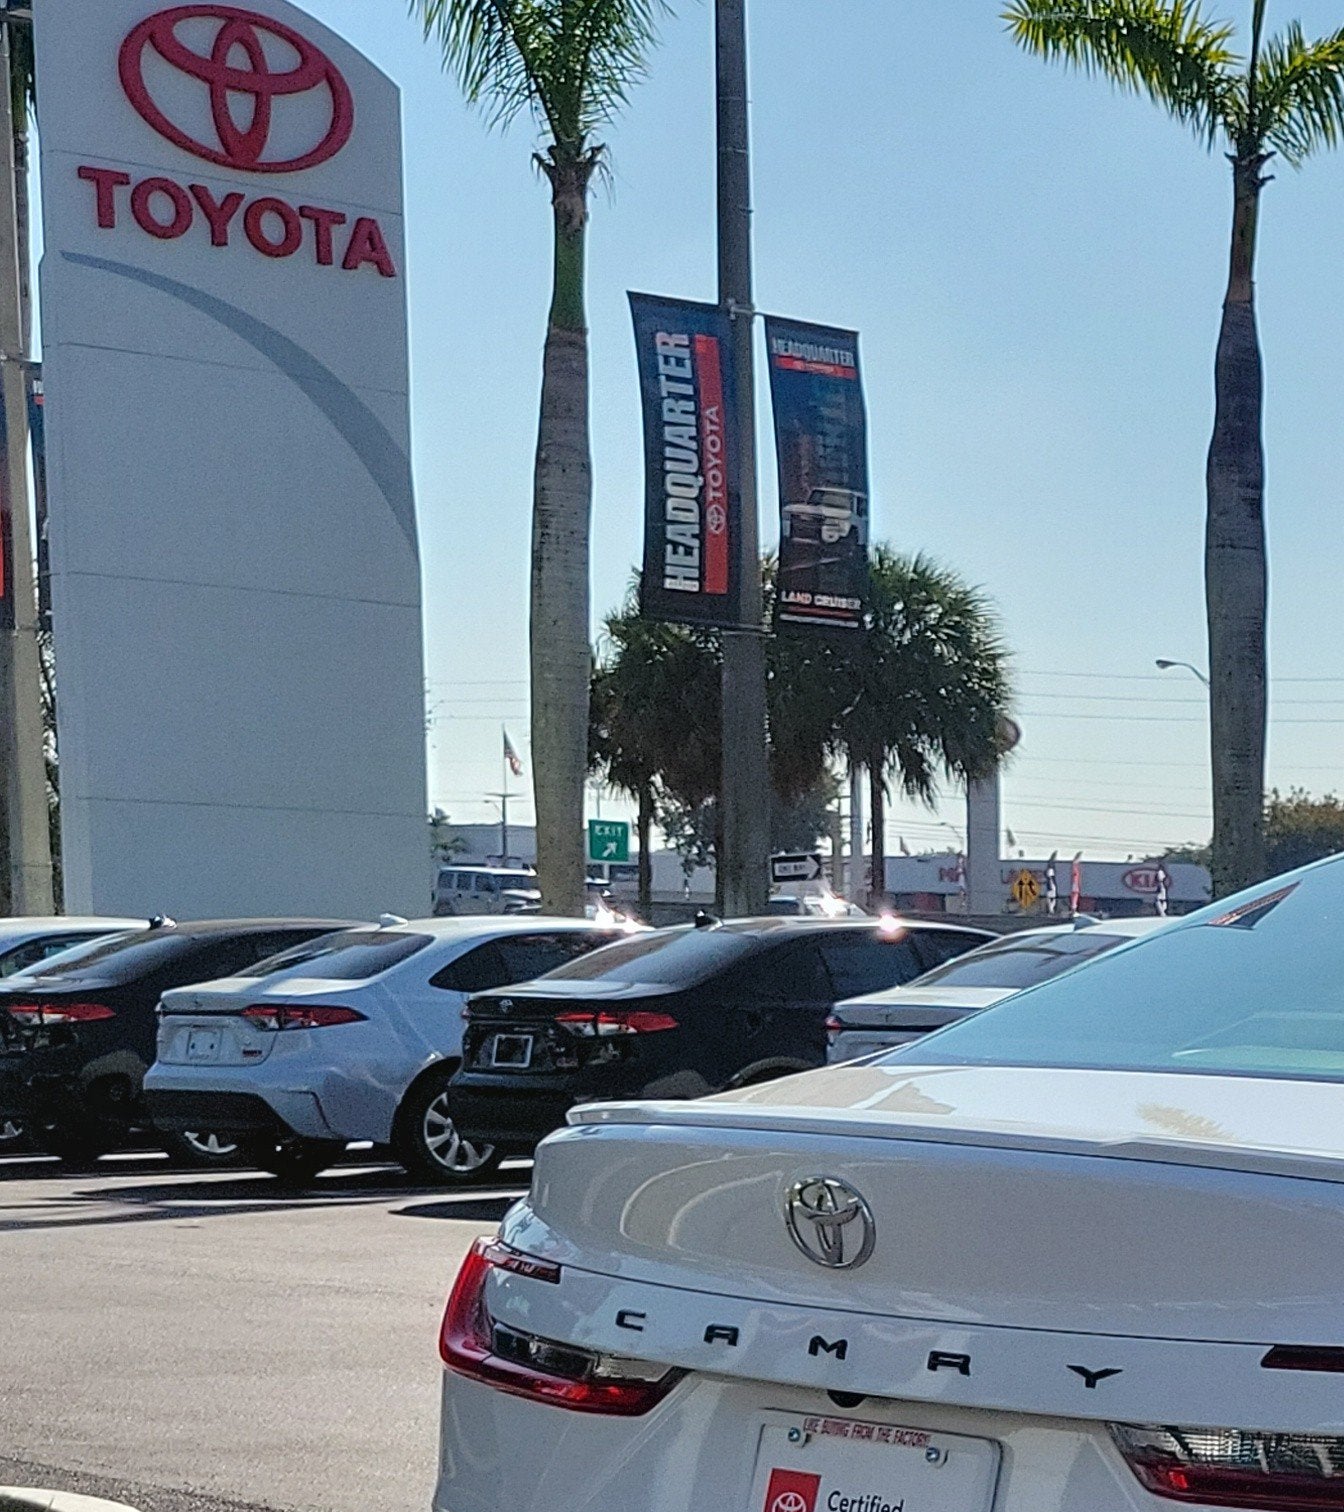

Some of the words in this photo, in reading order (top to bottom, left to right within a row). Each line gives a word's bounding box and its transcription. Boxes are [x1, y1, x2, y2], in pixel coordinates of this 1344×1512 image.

[77, 165, 397, 278] TOYOTA
[656, 331, 704, 592] HEADQUARTER
[703, 404, 724, 501] TOYOTA
[781, 590, 812, 605] LAND
[614, 1308, 1123, 1389] CAMRY
